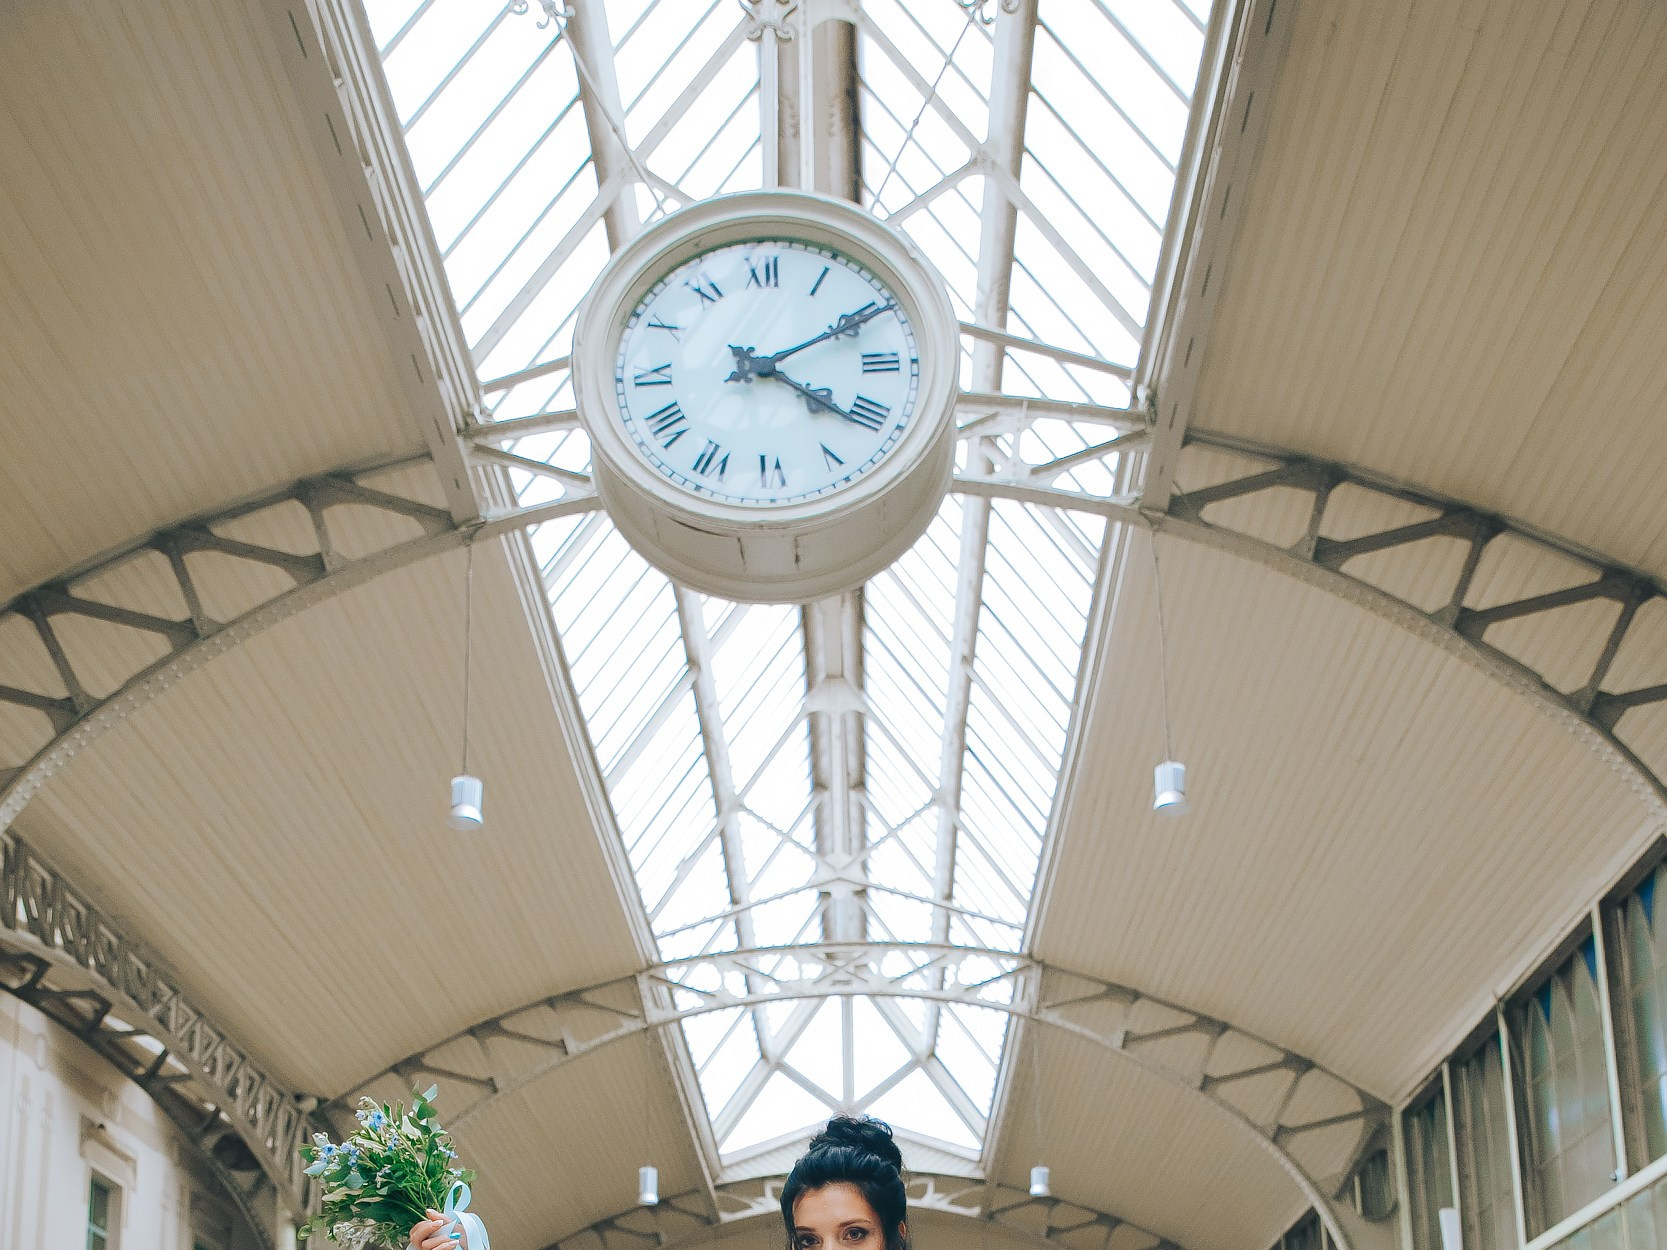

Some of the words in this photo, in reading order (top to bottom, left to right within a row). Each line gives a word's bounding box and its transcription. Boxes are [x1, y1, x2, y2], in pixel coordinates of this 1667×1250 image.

[744, 256, 780, 290] XII
[808, 266, 830, 296] I
[682, 271, 725, 310] XI
[646, 312, 686, 343] X
[633, 363, 673, 388] IX
[861, 352, 900, 374] III
[644, 400, 692, 450] VIII
[849, 394, 893, 433] IIII
[692, 438, 731, 484] VII
[758, 454, 788, 489] VI
[819, 442, 846, 472] V
